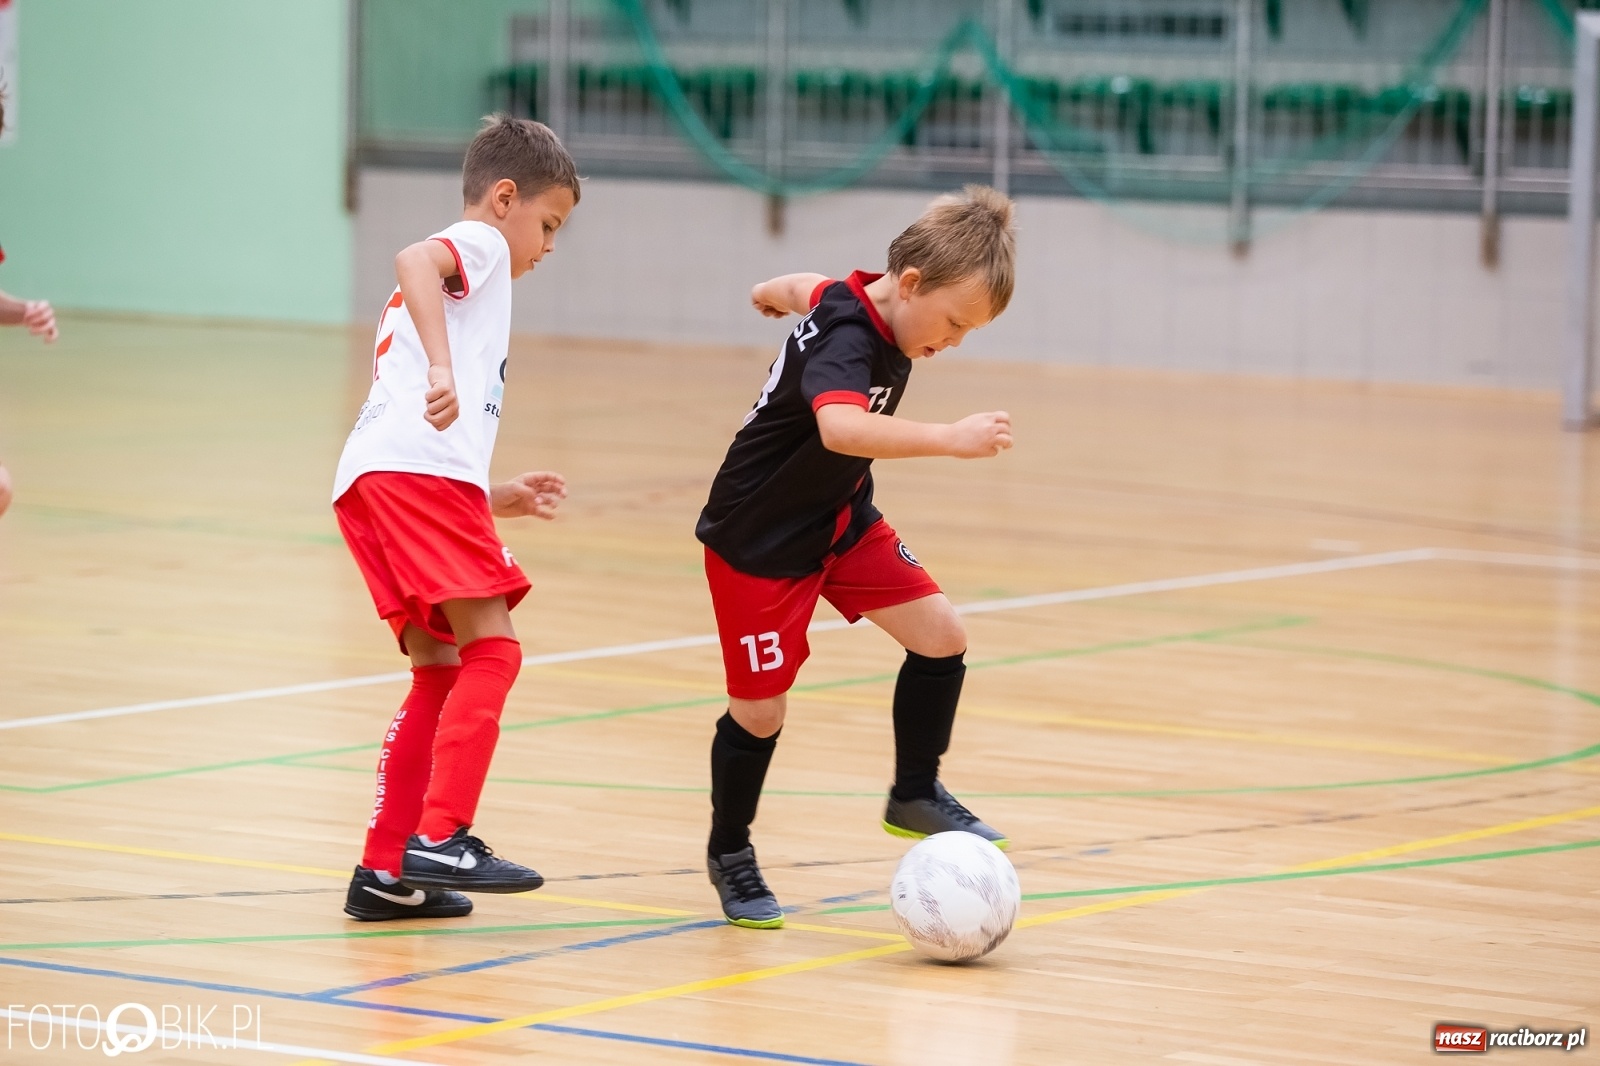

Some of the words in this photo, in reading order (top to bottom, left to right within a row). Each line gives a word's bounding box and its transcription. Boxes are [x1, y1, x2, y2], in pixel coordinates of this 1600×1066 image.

[740, 631, 784, 673] 13
[386, 710, 407, 742] UKS
[369, 748, 391, 829] CIESZYN
